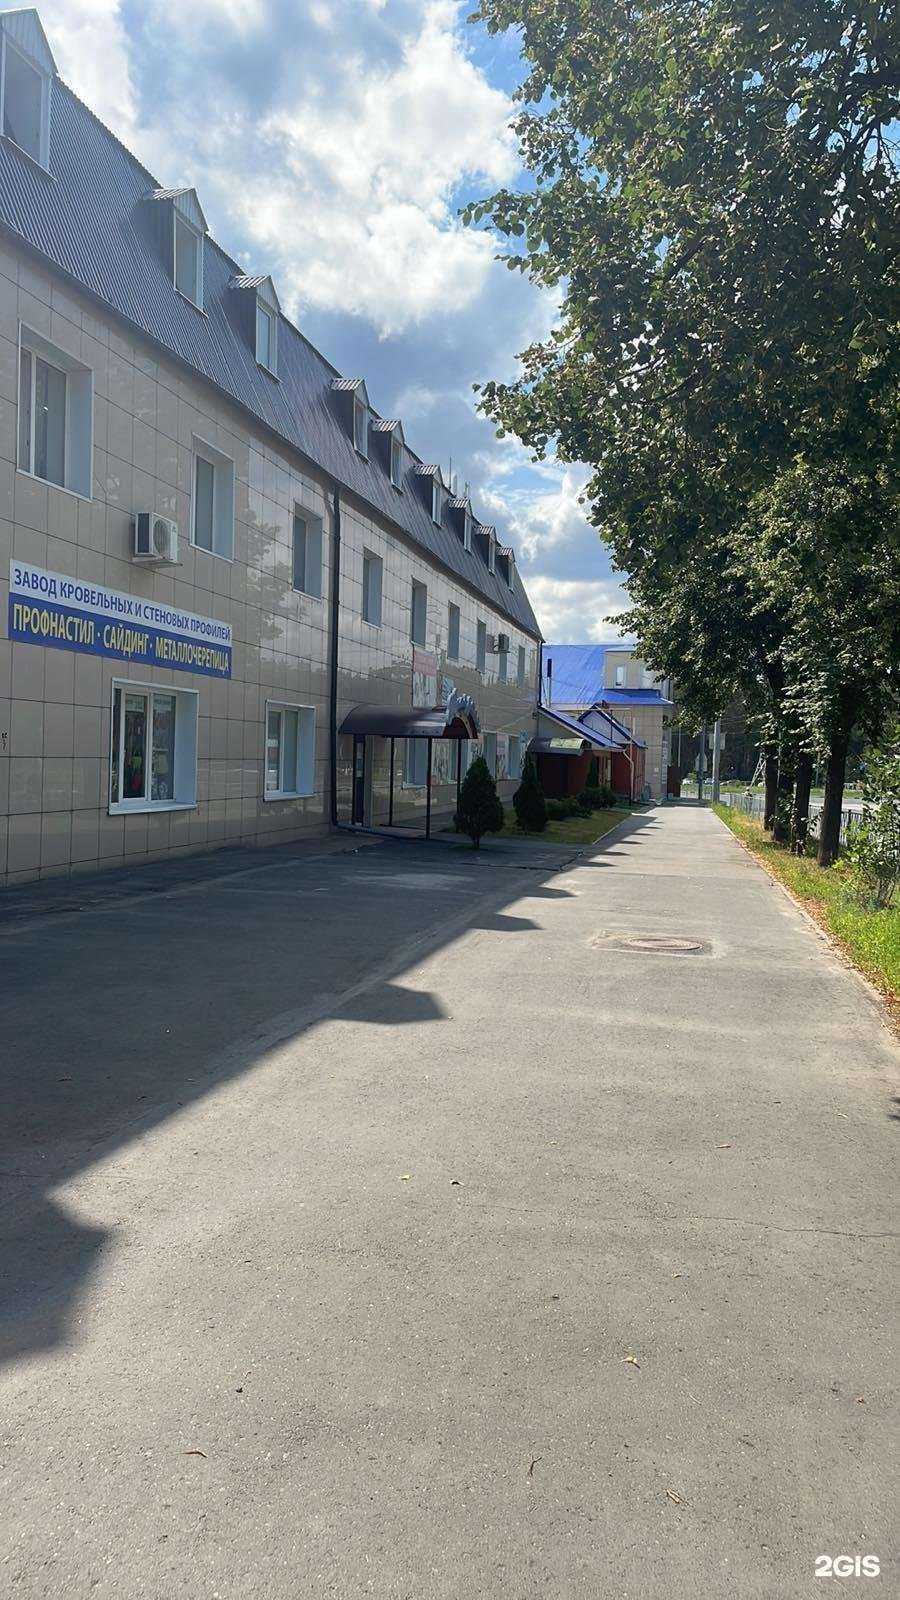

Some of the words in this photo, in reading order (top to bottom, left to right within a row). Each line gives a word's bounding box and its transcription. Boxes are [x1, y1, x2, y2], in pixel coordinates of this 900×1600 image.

[13, 604, 94, 645] ПРОФНАСТИЛ
[103, 623, 149, 658] САЙДИНГ
[155, 636, 229, 674] МЕТАЛЛОЧЕРЕПИЦА
[14, 568, 57, 599] ЗАВОД
[60, 582, 133, 615] КРОВЕЛЬНЫХ
[135, 604, 142, 618] И
[144, 605, 190, 630] СТЕНОВЫХ
[190, 620, 231, 641] ПРОФИЛЕЙ
